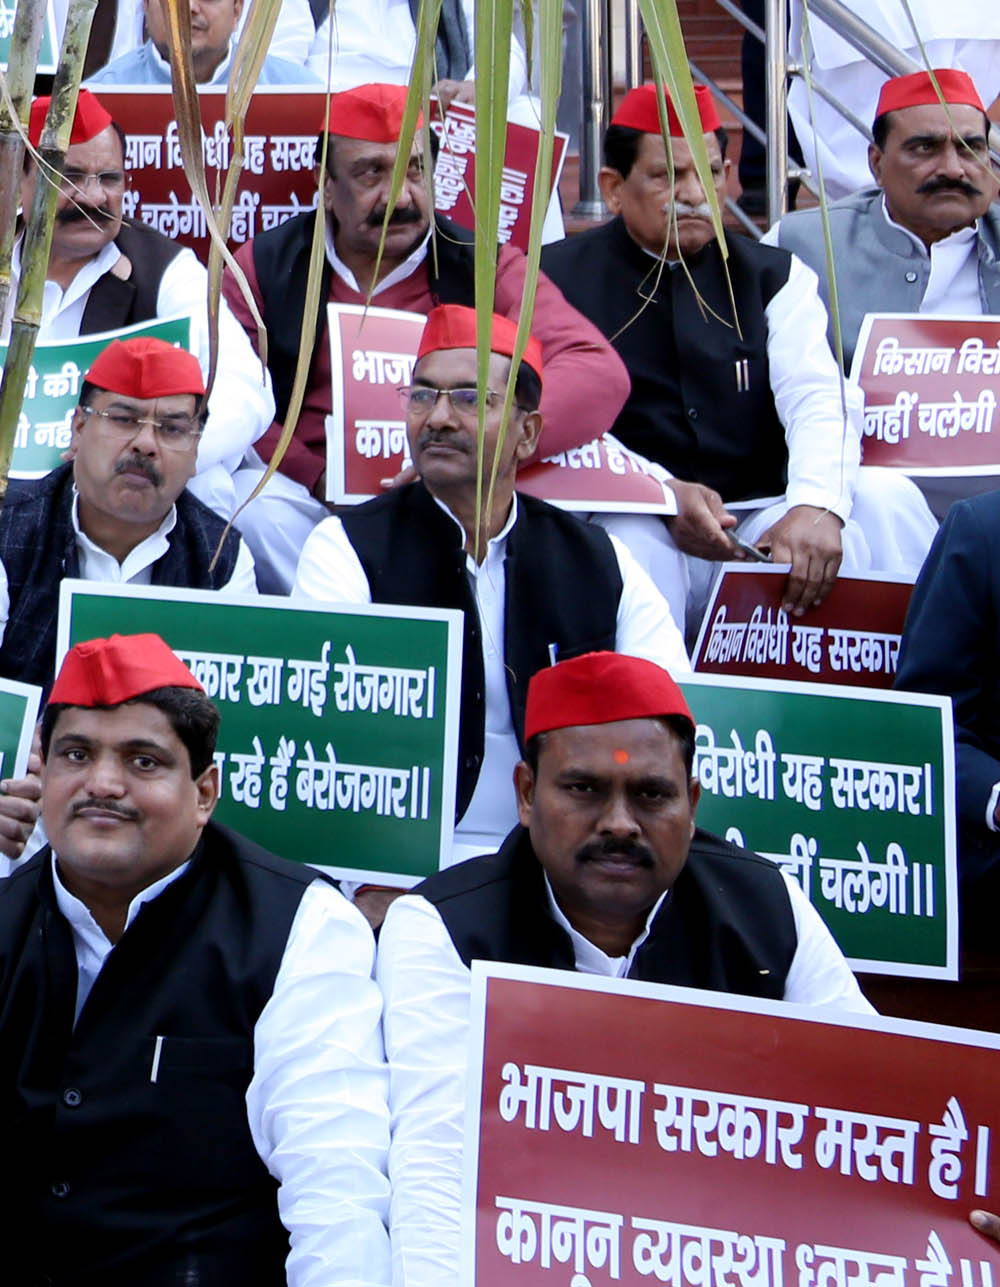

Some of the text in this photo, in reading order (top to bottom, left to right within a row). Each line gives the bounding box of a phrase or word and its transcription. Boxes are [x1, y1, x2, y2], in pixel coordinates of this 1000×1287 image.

[353, 349, 418, 386] भाज
[873, 337, 956, 376] किसान
[863, 389, 997, 444] नहीं चलेगी
[703, 604, 748, 663] किसान
[743, 604, 790, 665] विरोधी
[792, 625, 825, 673] यह
[247, 655, 284, 706] खा
[287, 640, 332, 718] गई
[333, 643, 436, 719] रोजगार।
[229, 735, 266, 809] रहे
[269, 735, 297, 811] हैं
[296, 739, 430, 821] बेरोजगार।।
[780, 753, 825, 811] यह
[829, 757, 934, 816] सरकार।
[819, 841, 935, 918] चलेगी।।
[499, 1061, 645, 1145] भाजपा
[653, 1082, 809, 1170] सरकार
[814, 1105, 920, 1185] मस्त
[495, 1195, 624, 1287] कानून
[631, 1216, 786, 1287] व्यवस्था
